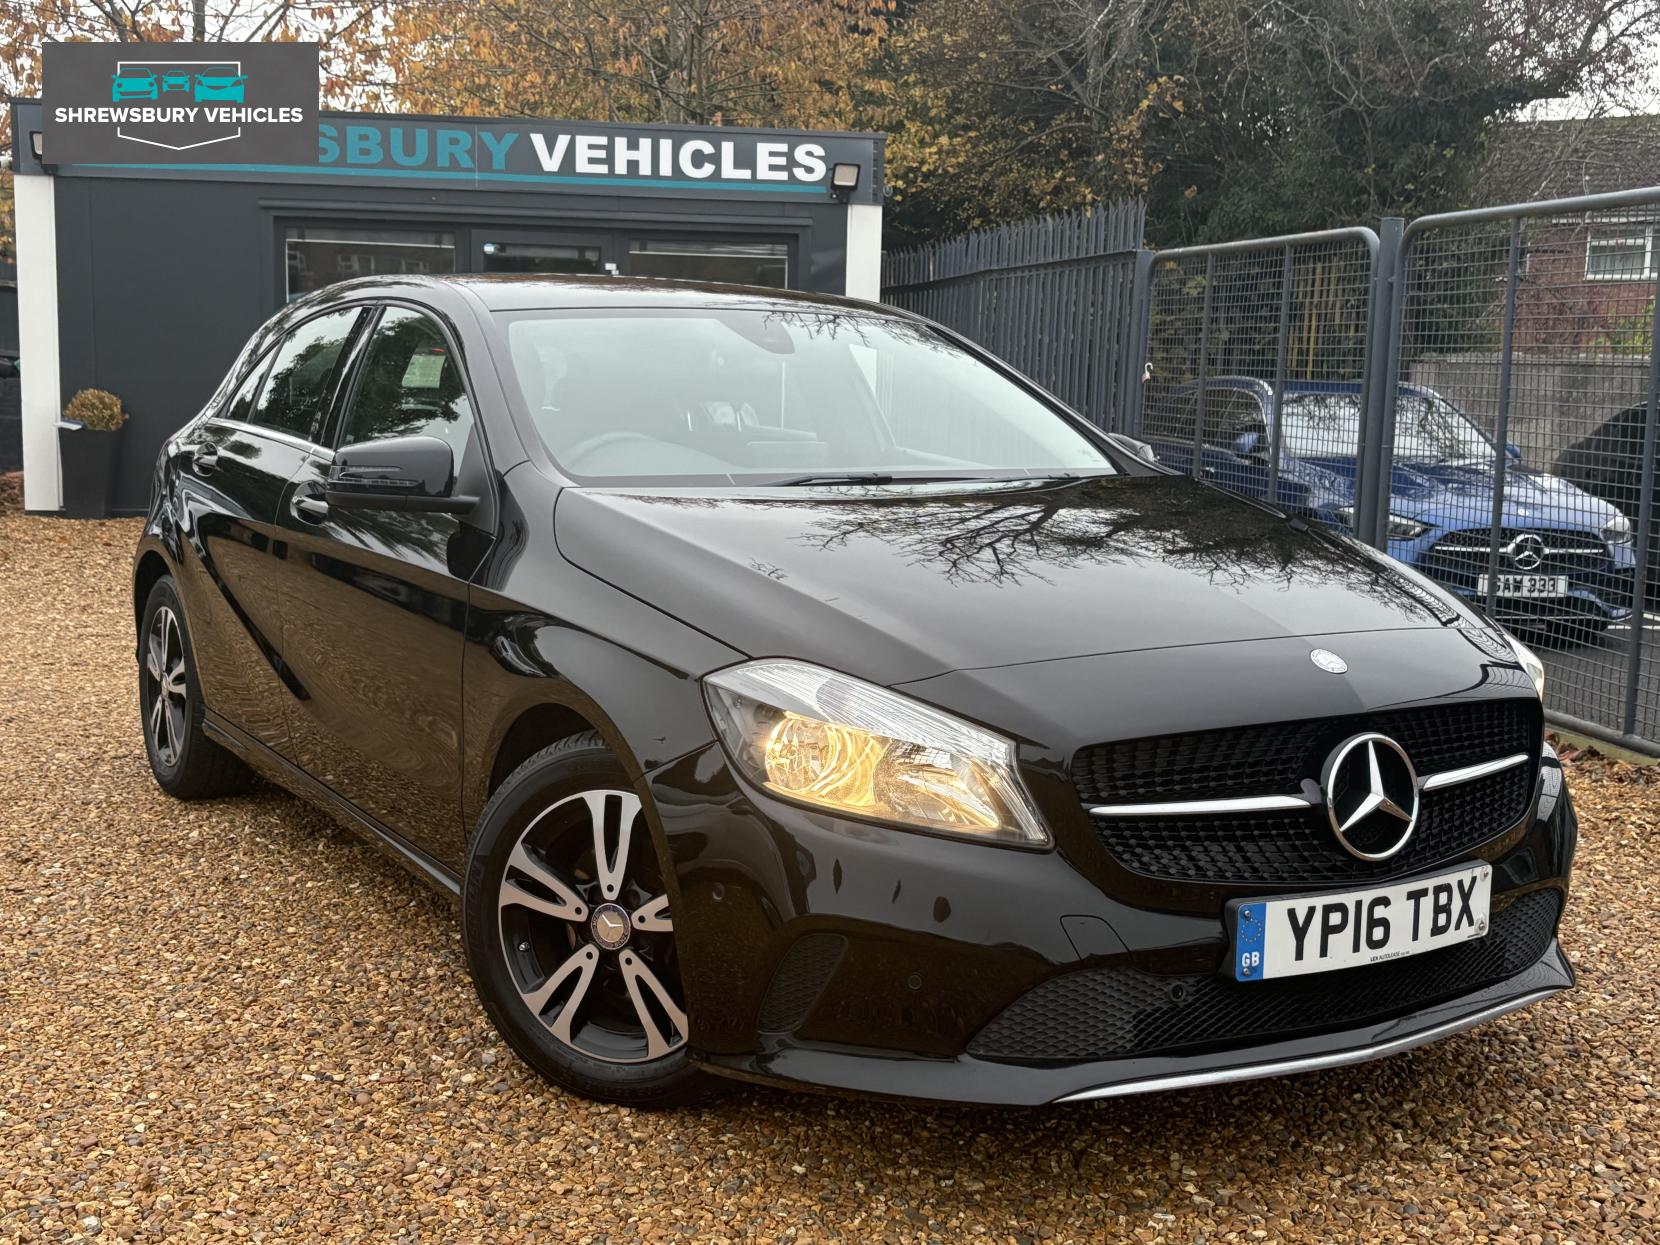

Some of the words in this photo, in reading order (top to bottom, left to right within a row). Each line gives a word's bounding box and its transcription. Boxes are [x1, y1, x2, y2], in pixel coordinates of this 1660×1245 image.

[530, 132, 827, 181] VEHICLES
[1287, 896, 1391, 961] YP16
[1406, 876, 1477, 942] TBX
[1241, 952, 1260, 967] GB
